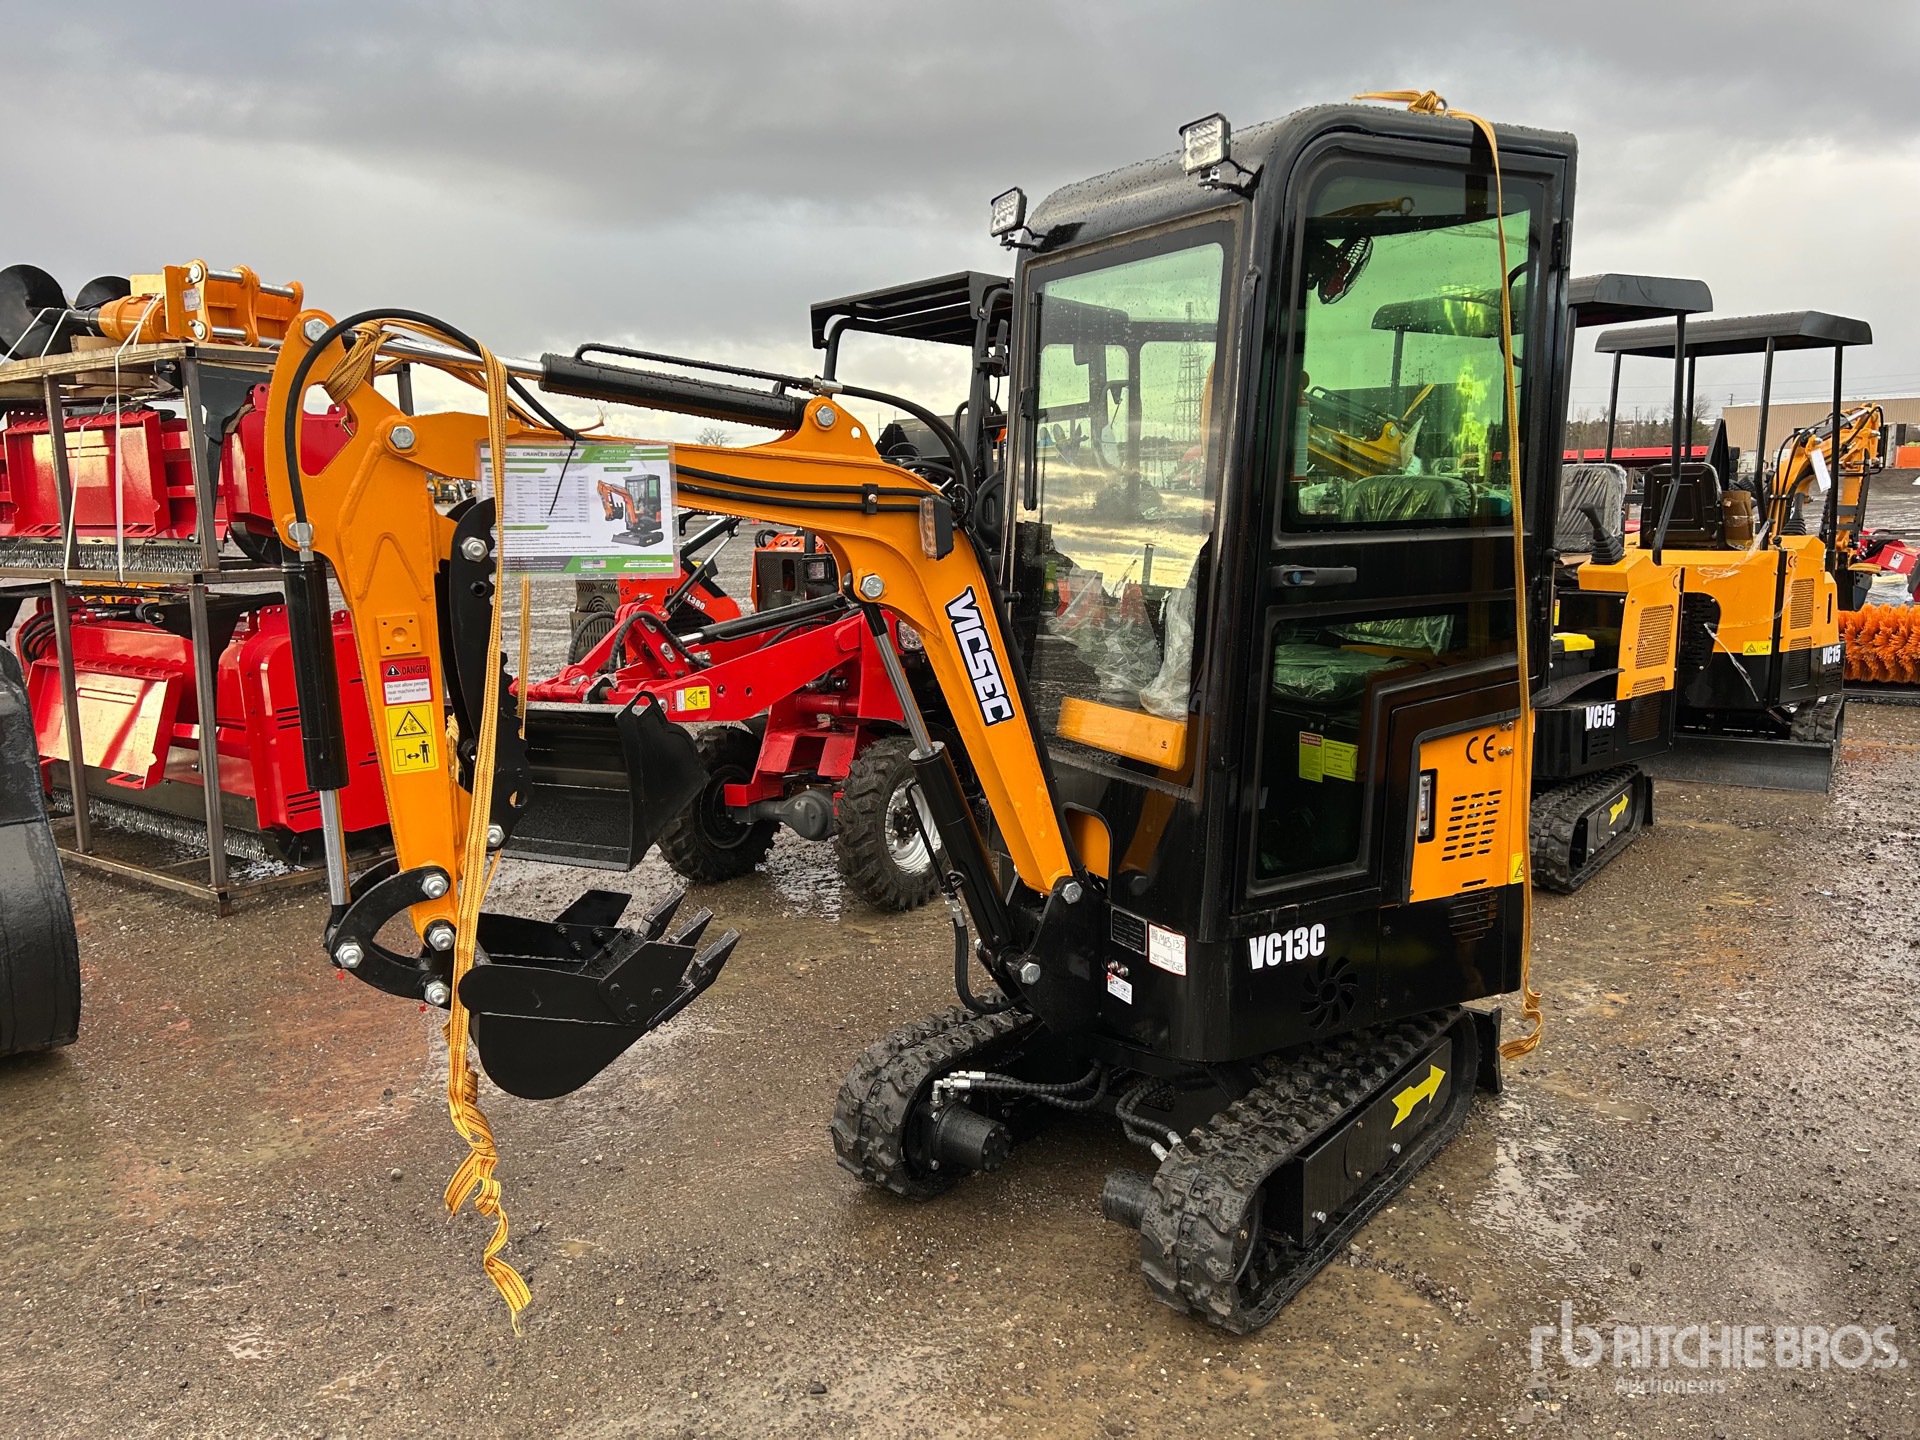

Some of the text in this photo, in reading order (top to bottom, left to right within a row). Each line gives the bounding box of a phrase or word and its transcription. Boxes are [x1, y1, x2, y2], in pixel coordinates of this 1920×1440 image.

[945, 586, 1014, 725] VICSEC
[1822, 644, 1842, 665] VC15
[402, 664, 428, 675] DANGER
[1585, 703, 1616, 729] VC15
[1465, 733, 1496, 764] CE
[1248, 923, 1326, 970] VC13C
